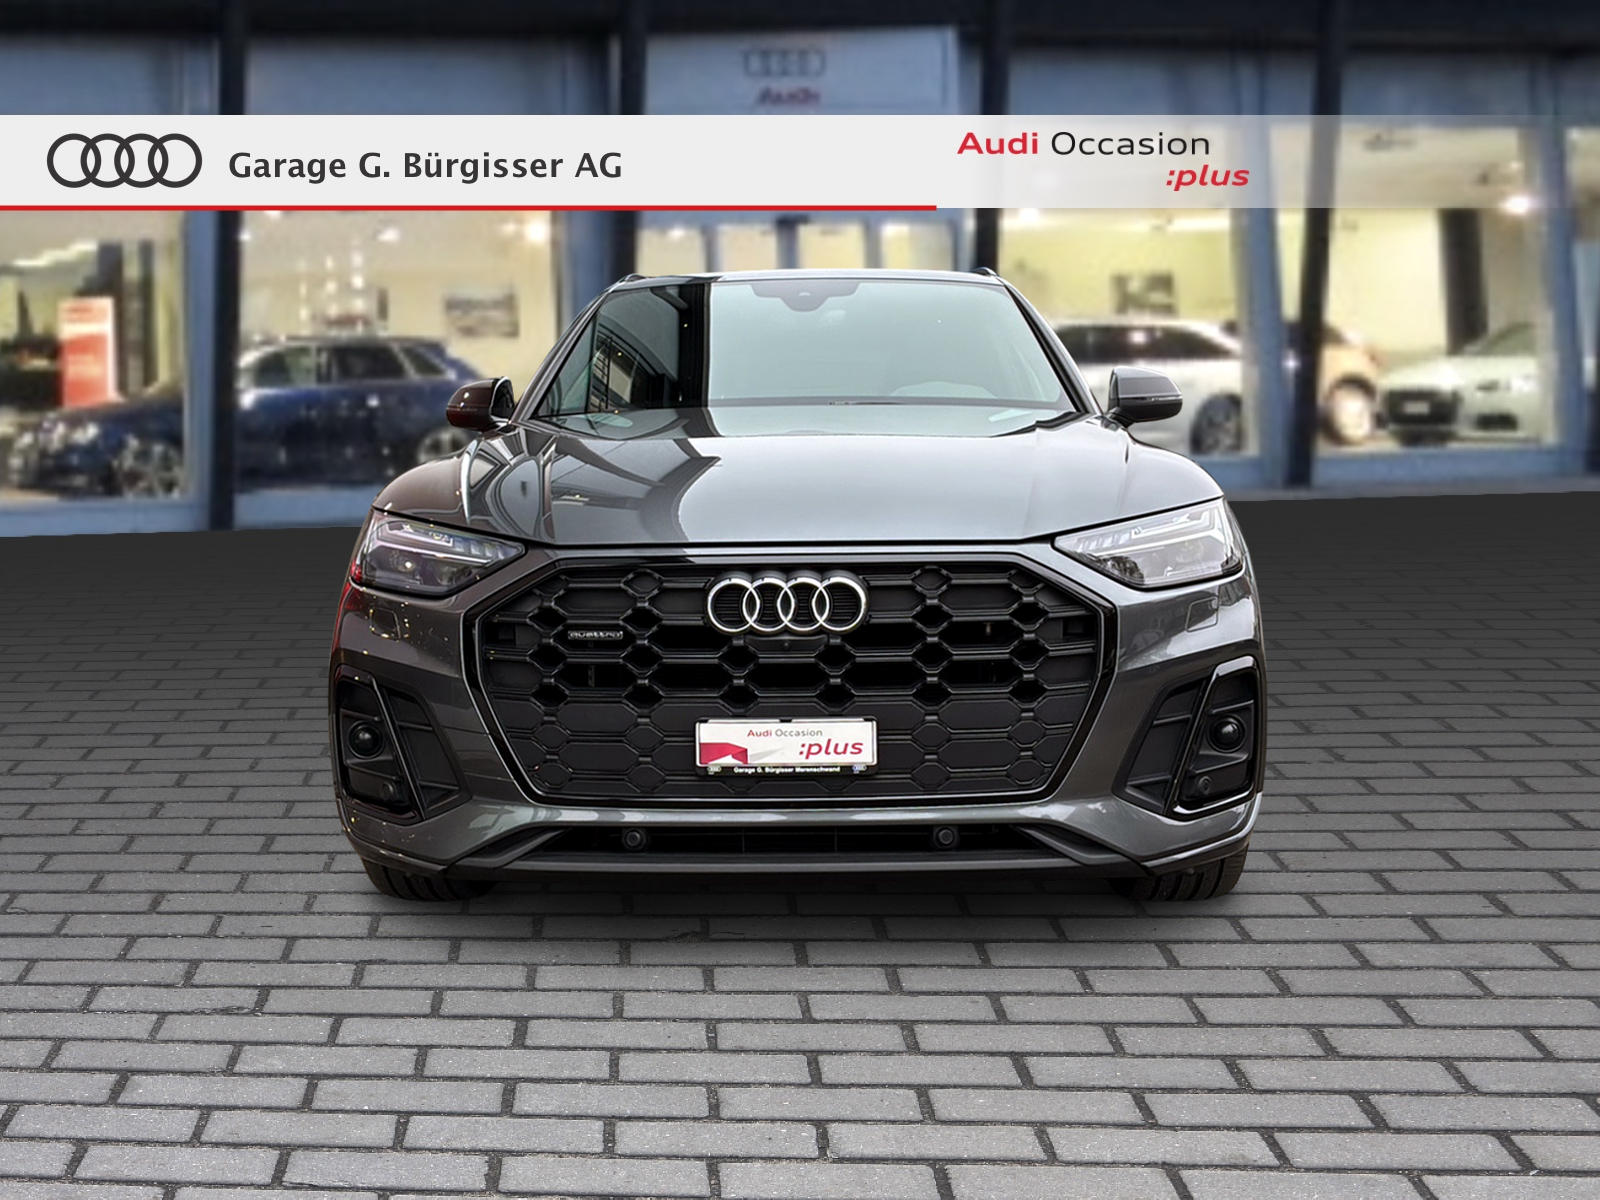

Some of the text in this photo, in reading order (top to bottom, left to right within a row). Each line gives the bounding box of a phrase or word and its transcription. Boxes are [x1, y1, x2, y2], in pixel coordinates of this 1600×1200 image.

[747, 728, 823, 737] Audi Occasion
[799, 738, 864, 760] :plus
[733, 766, 755, 774] Garage
